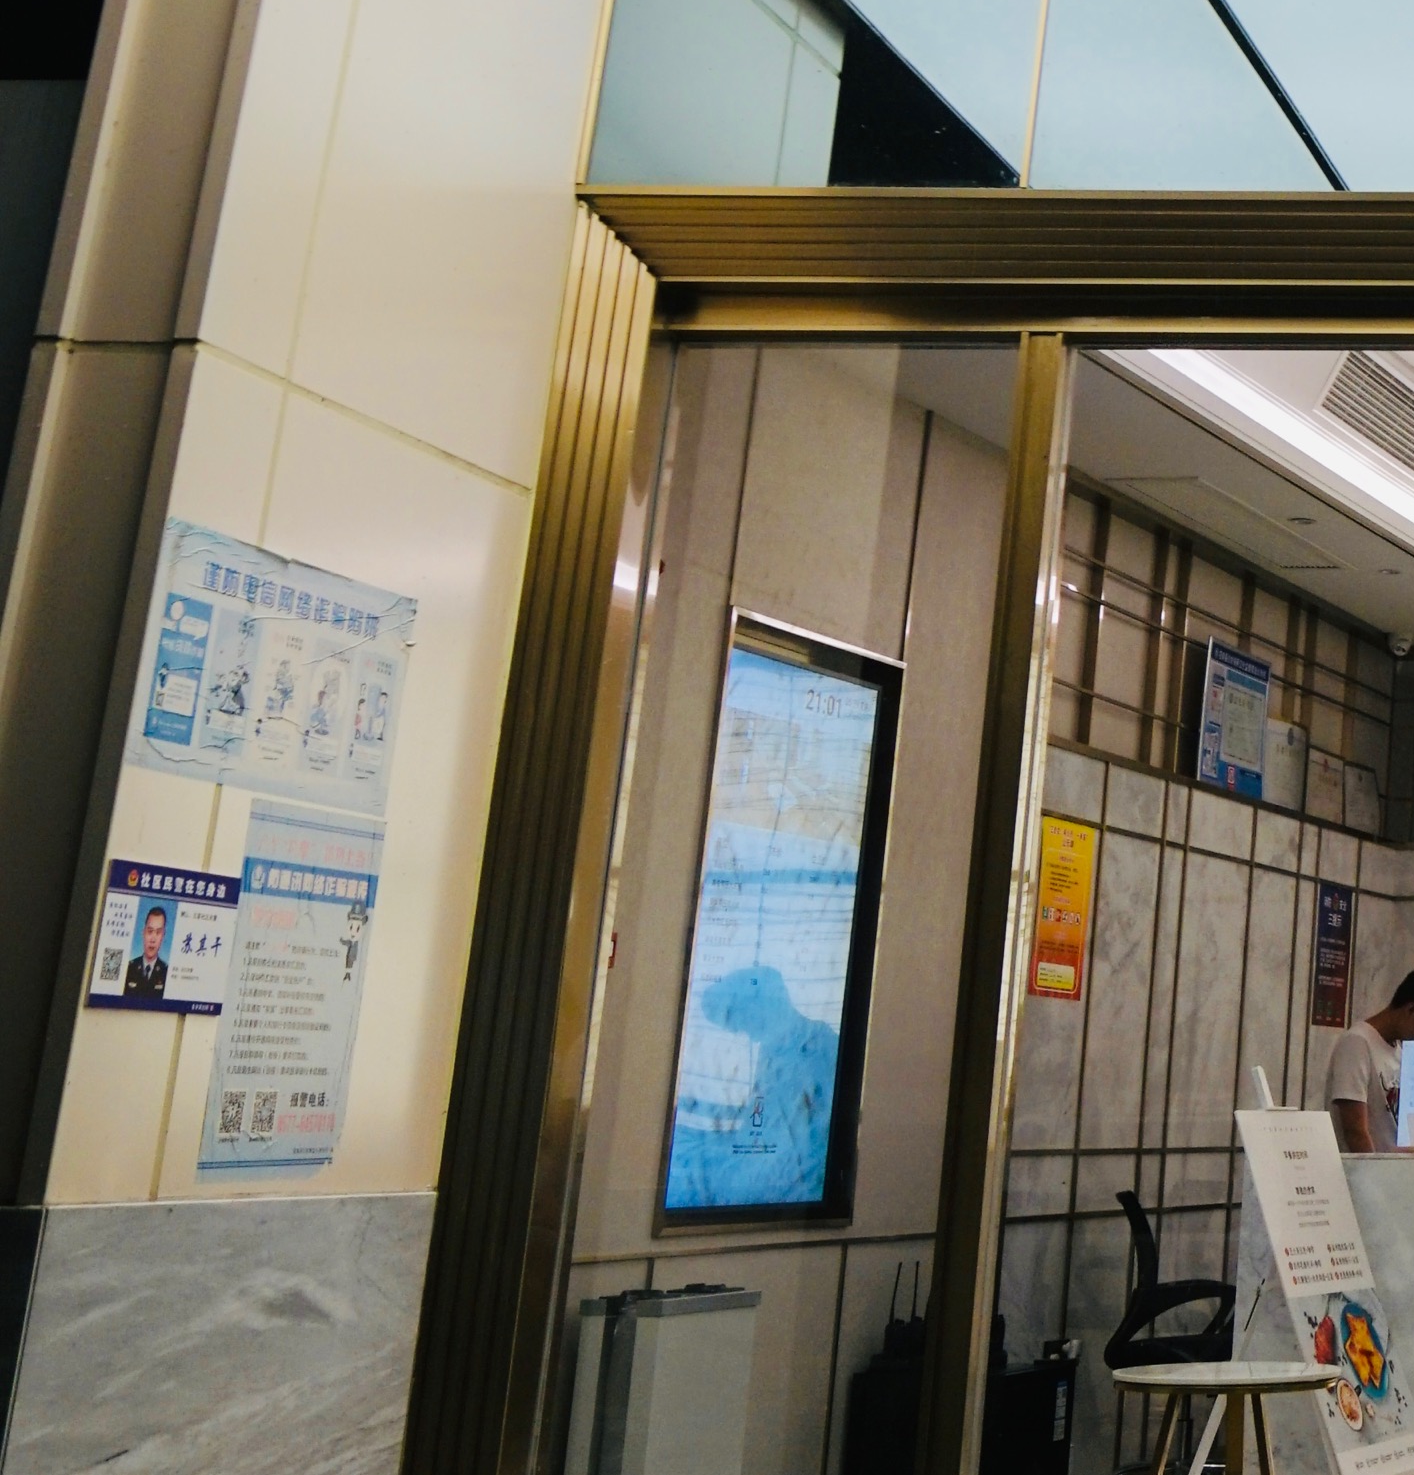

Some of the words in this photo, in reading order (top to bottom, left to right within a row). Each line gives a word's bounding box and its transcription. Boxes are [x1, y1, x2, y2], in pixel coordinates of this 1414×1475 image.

[806, 689, 841, 718] 21:01
[141, 872, 226, 898] 社区民警在您身边
